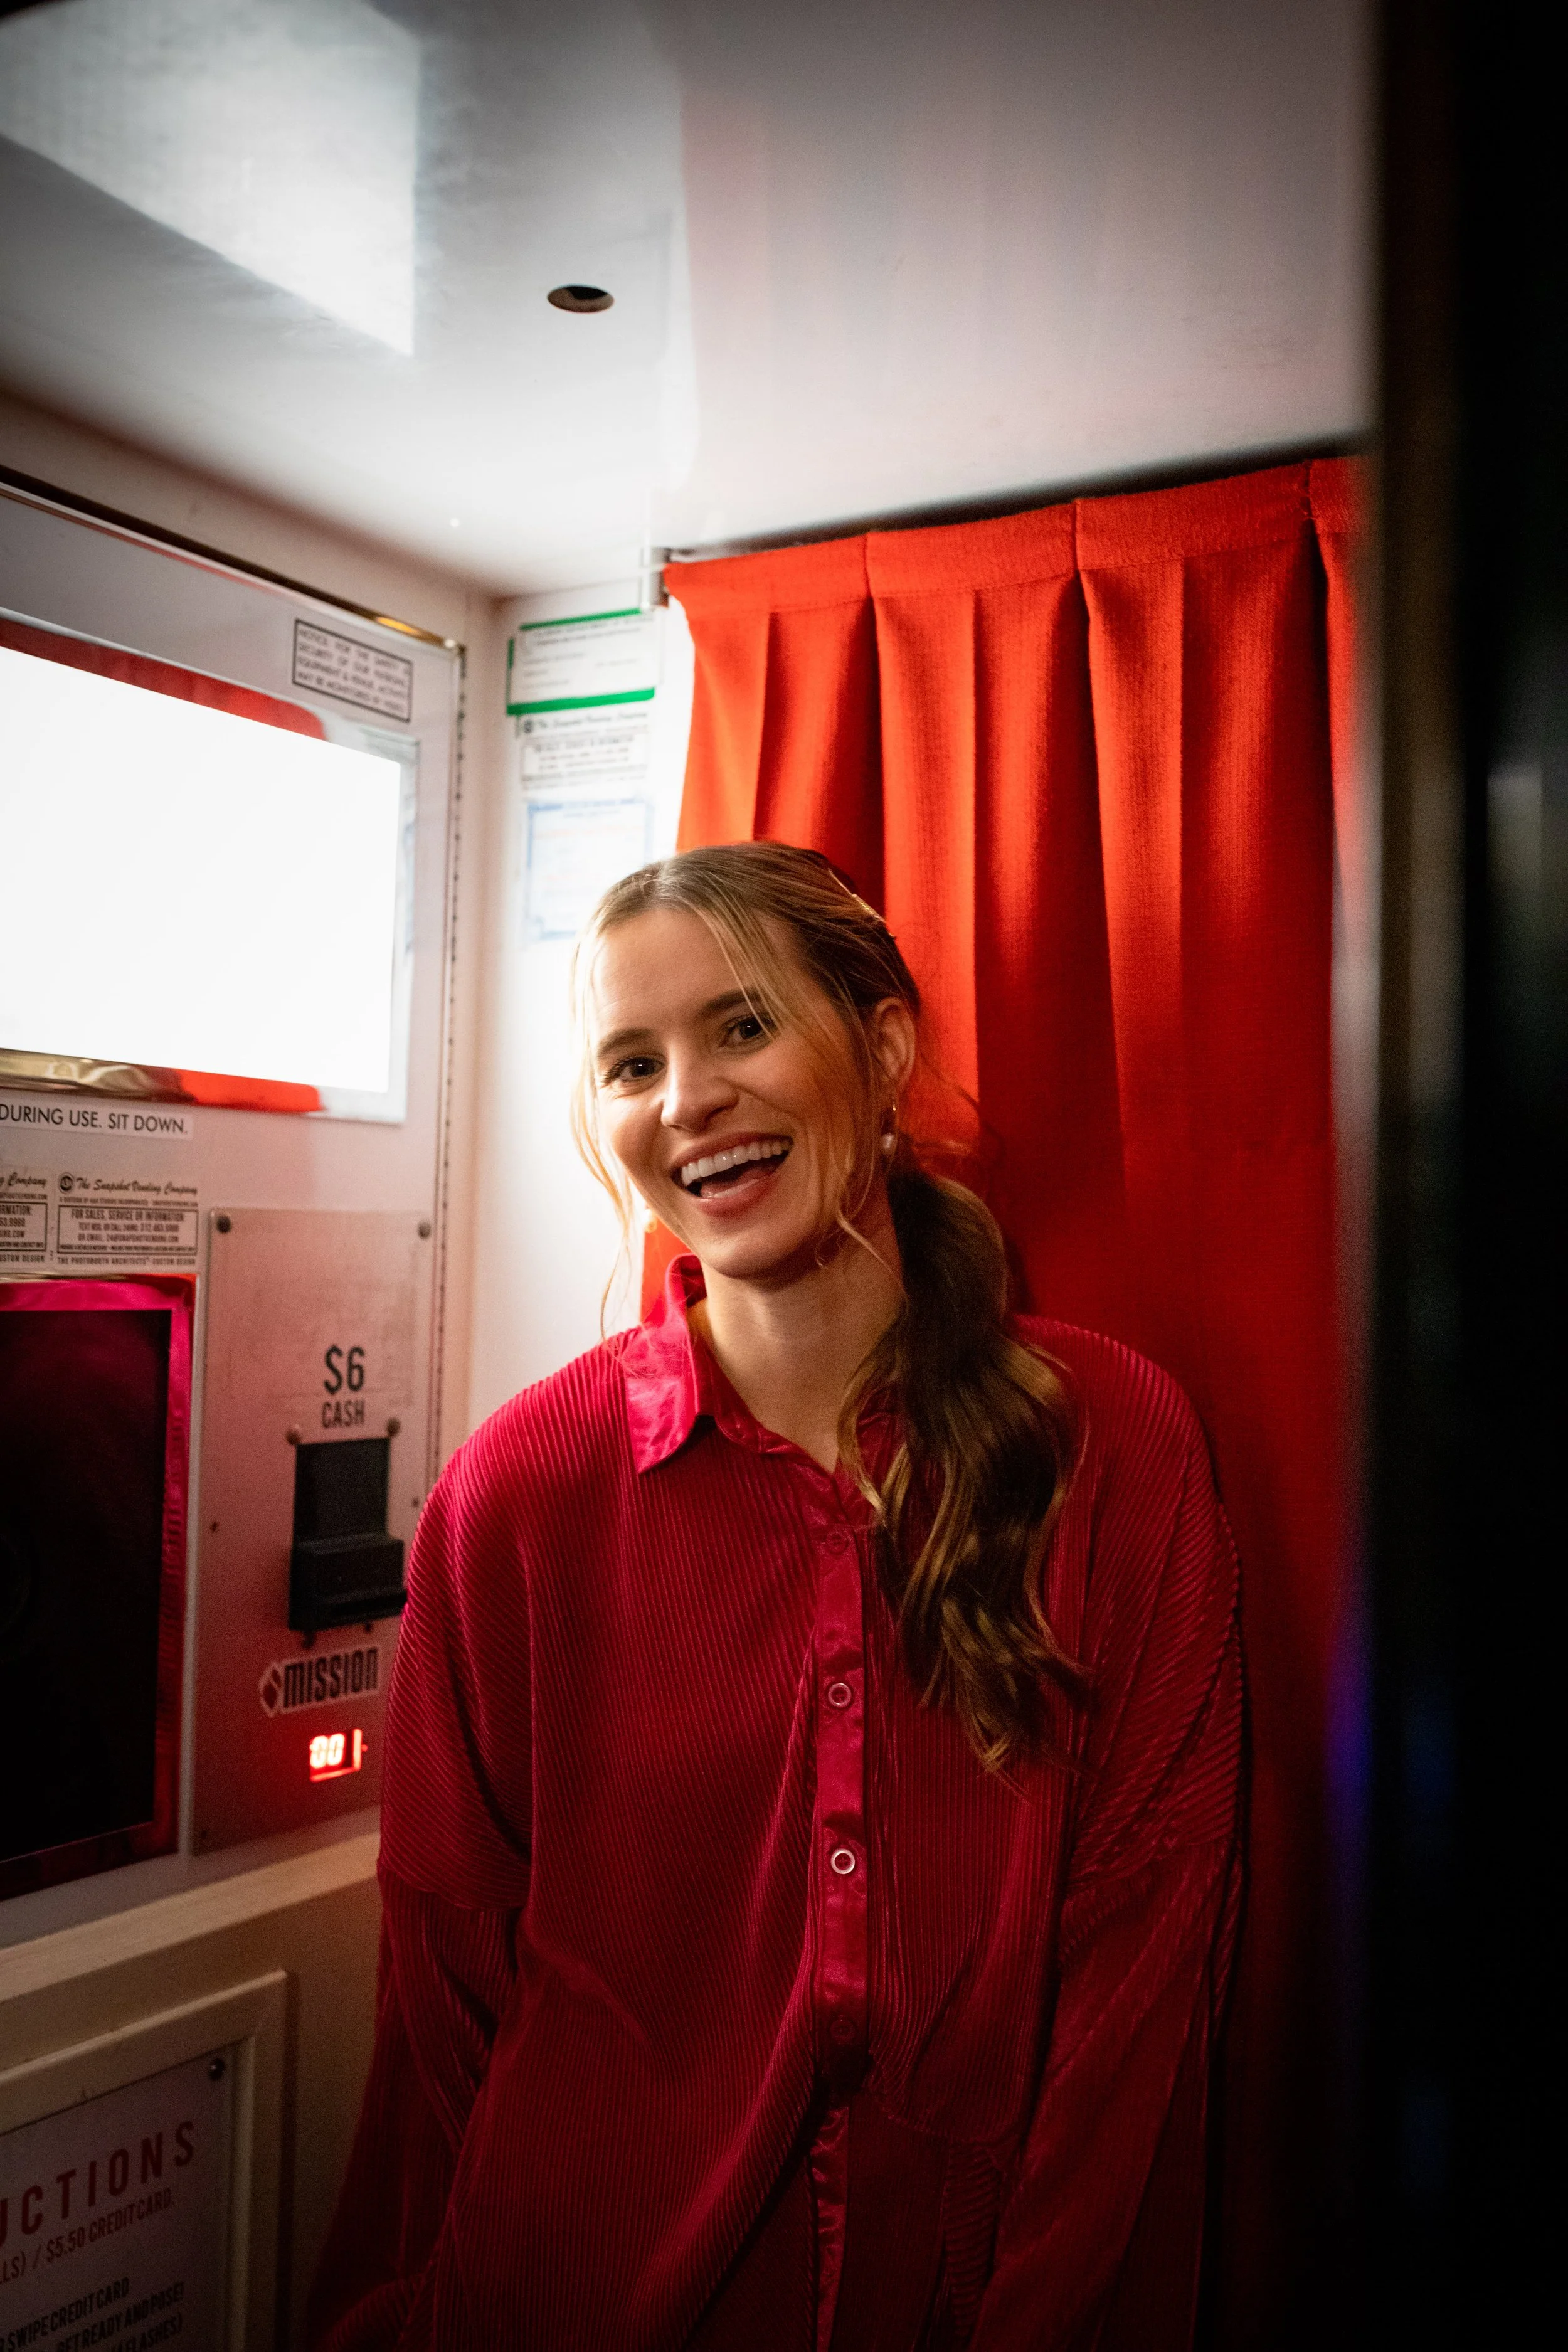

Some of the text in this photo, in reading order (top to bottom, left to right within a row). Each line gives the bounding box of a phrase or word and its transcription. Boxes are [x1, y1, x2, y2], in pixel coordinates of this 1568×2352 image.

[0, 1103, 188, 1134] DURING USE. SIT DOWN.
[71, 1208, 83, 1219] FOR
[22, 1254, 45, 1263] DESIGN
[321, 1399, 365, 1429] CASH
[0, 2250, 26, 2285] LS)
[88, 2203, 135, 2243] CREDIT
[137, 2186, 172, 2221] CARD
[7, 2276, 130, 2352] SWIPE CREDIT CARD
[82, 2311, 123, 2349] READY
[124, 2298, 149, 2328] AND
